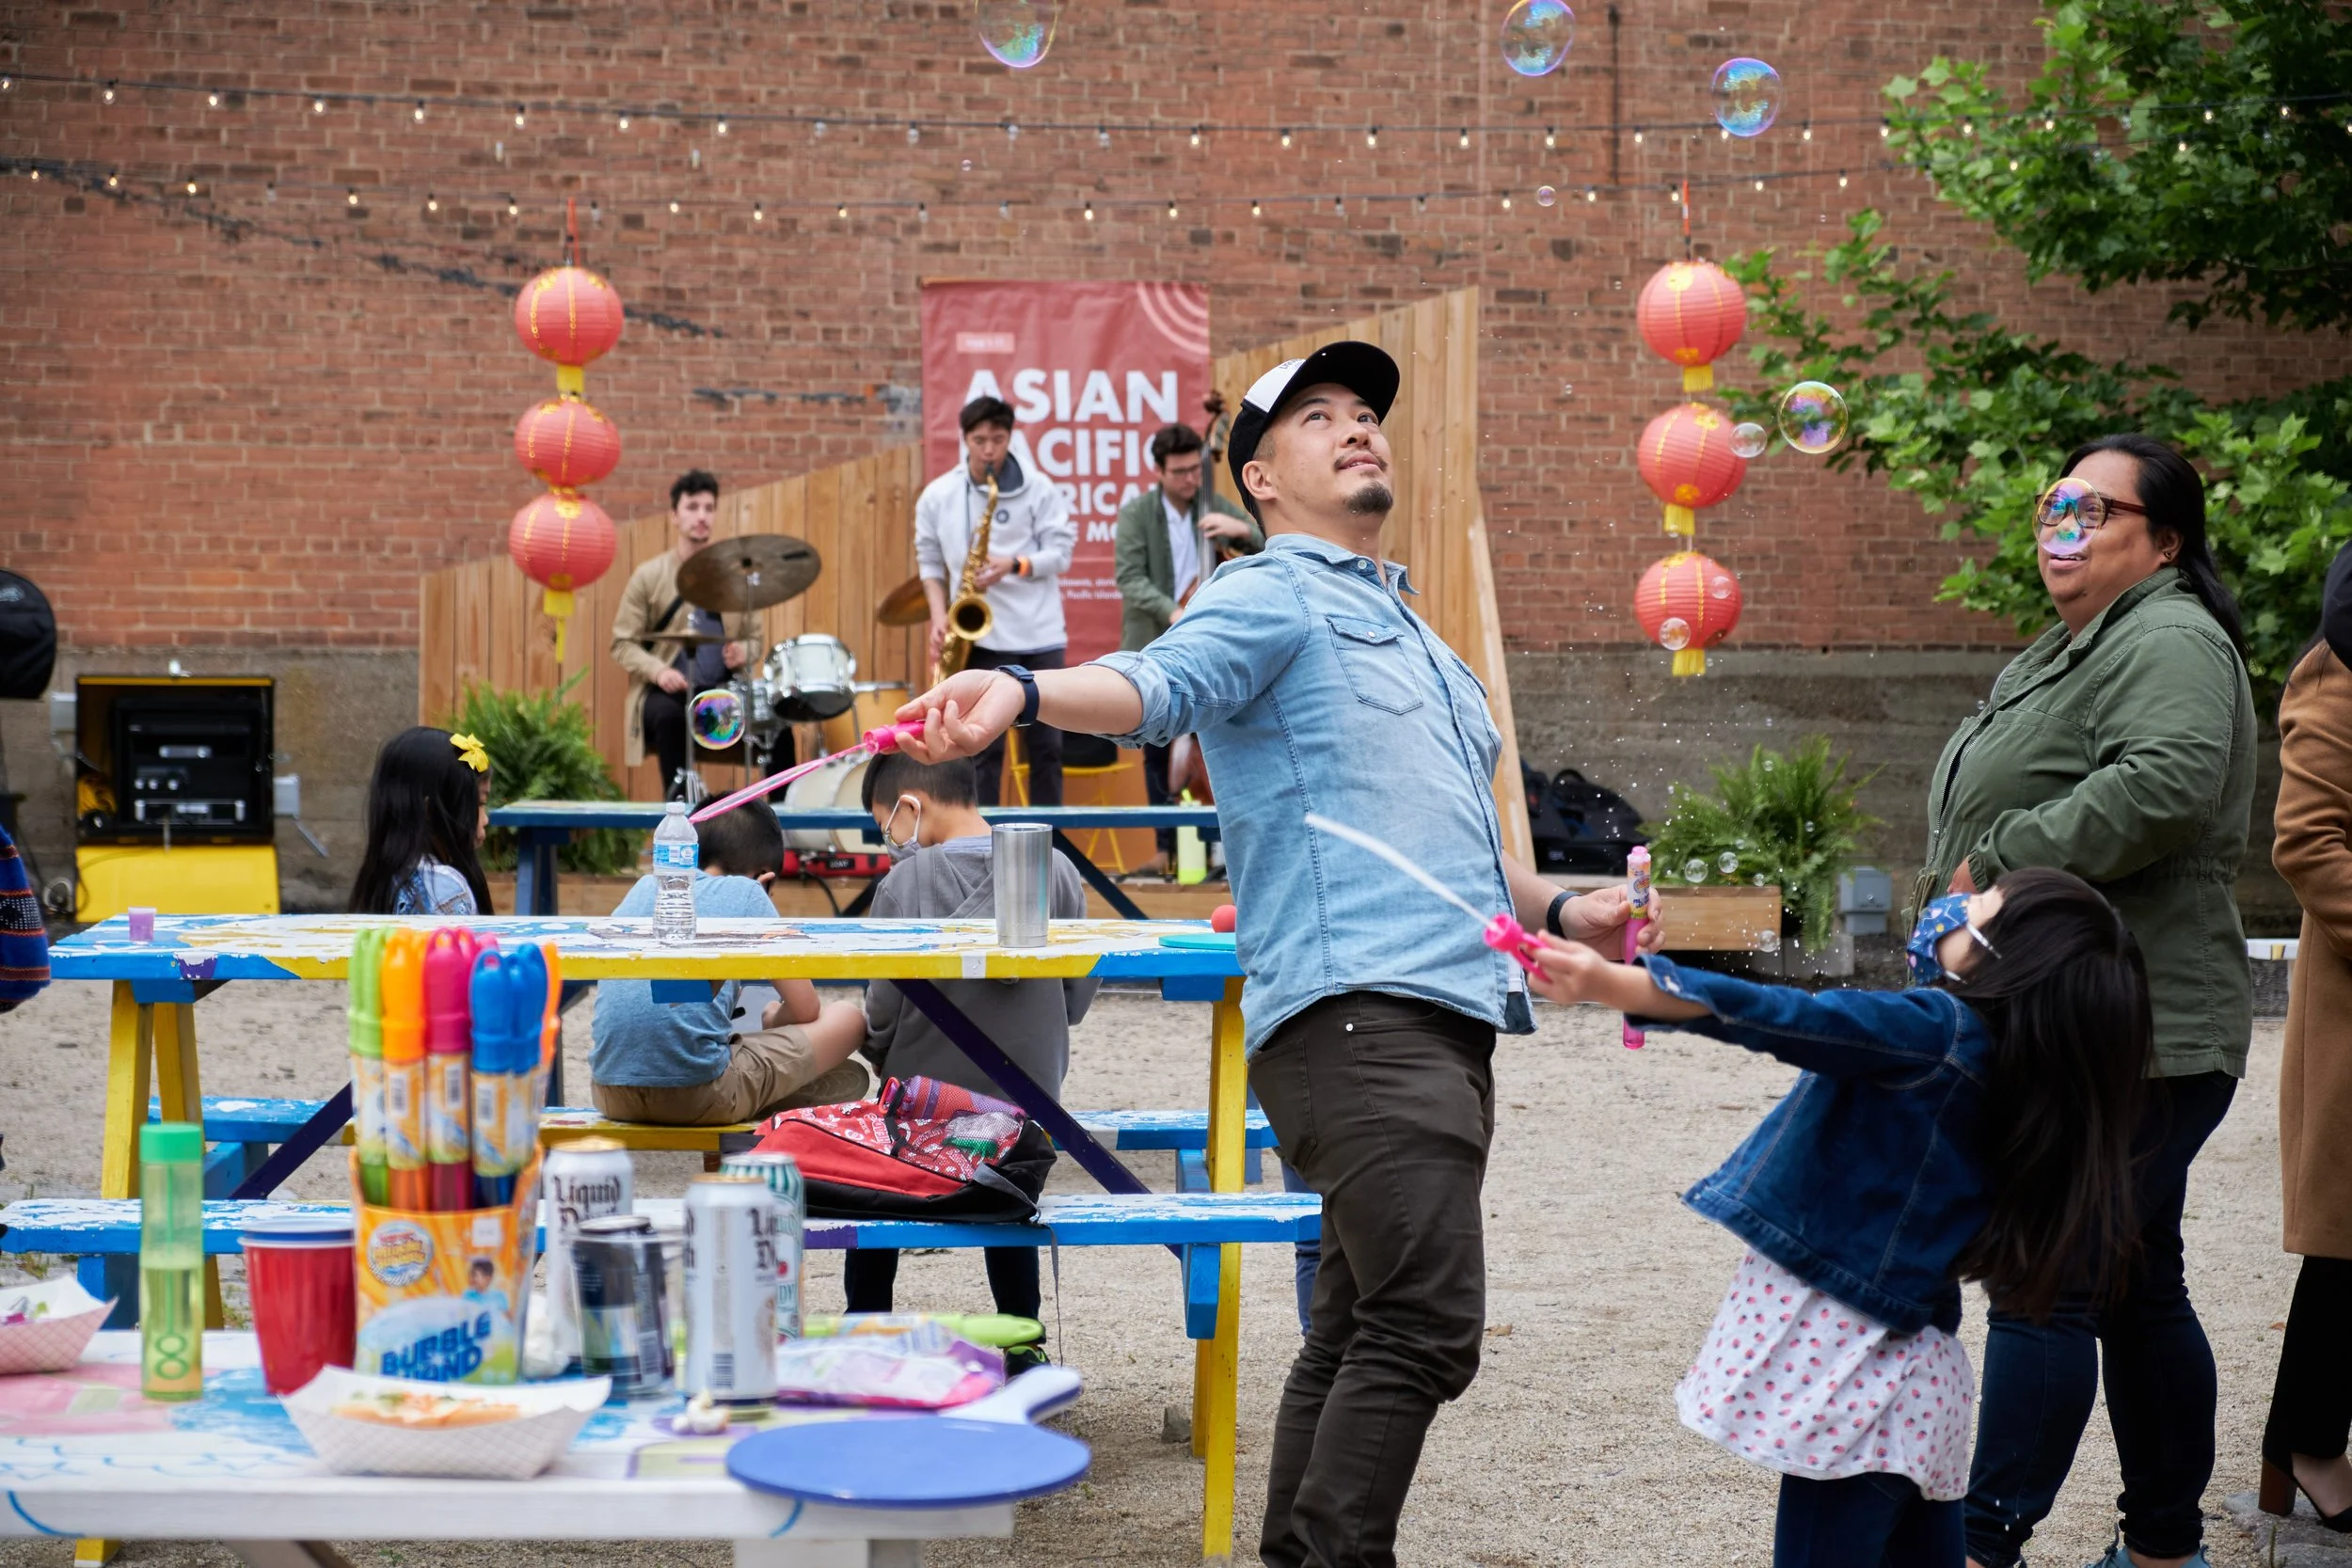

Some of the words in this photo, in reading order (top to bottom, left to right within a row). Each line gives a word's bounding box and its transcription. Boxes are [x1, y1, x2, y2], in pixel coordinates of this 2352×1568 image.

[963, 368, 1178, 423] ASIAN
[959, 427, 1158, 477] ACIFI
[381, 1310, 492, 1376] BUBBLE
